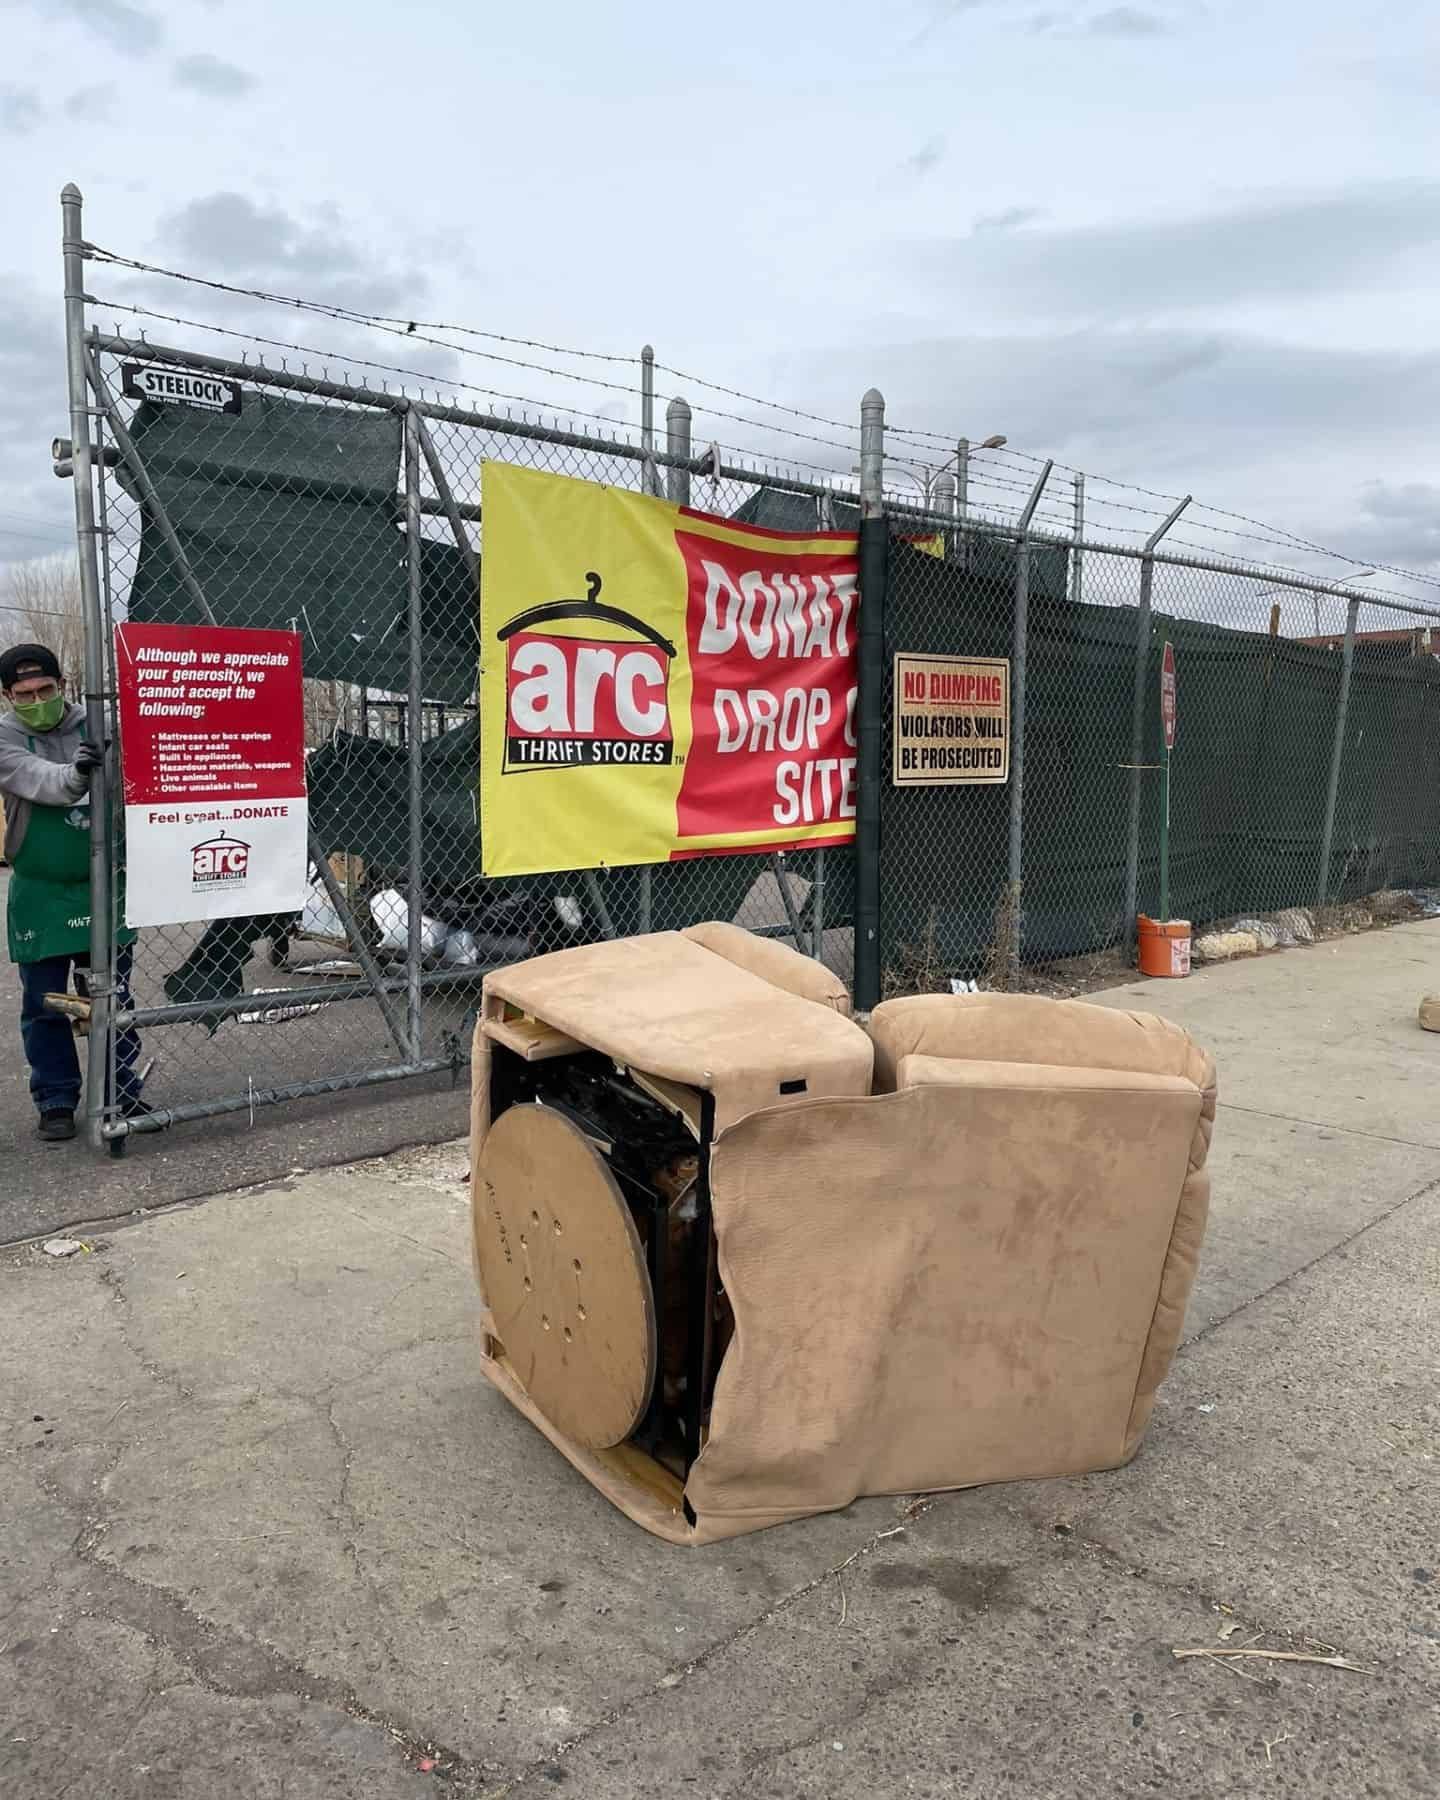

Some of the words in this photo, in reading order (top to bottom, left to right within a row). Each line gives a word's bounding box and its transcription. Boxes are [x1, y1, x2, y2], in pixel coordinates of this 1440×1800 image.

[145, 373, 223, 402] STEELOCK
[136, 648, 197, 665] Although
[201, 652, 220, 663] we
[224, 651, 289, 667] appreciate
[137, 668, 167, 682] your
[172, 669, 243, 684] generosity,
[247, 671, 265, 682] we
[138, 685, 185, 699] cannot
[188, 686, 233, 701] accept
[235, 686, 256, 699] the
[510, 641, 667, 736] arc
[904, 672, 925, 699] NO
[930, 673, 1001, 702] DUMPING
[139, 702, 205, 718] following:
[713, 687, 831, 753] DROP
[901, 715, 972, 738] VIOLATORS
[973, 716, 1003, 738] WILL
[158, 733, 209, 741] Mattresses
[222, 732, 238, 740] box
[241, 732, 272, 742] springs
[158, 743, 186, 751] Infant
[206, 743, 230, 751] seats
[518, 739, 584, 762] THRIFT
[591, 740, 665, 763] STORES
[159, 753, 181, 761] Built
[194, 753, 242, 763] appliances
[159, 763, 207, 772] Hazardous
[254, 761, 292, 771] weapons
[902, 748, 918, 769] BE
[921, 747, 1002, 769] PROSECUTED
[160, 774, 179, 782] Live
[182, 773, 217, 782] animals
[161, 784, 187, 792] Other
[233, 782, 258, 790] items
[773, 758, 857, 825] SITE
[149, 812, 179, 824] Feel
[194, 848, 247, 873] arc
